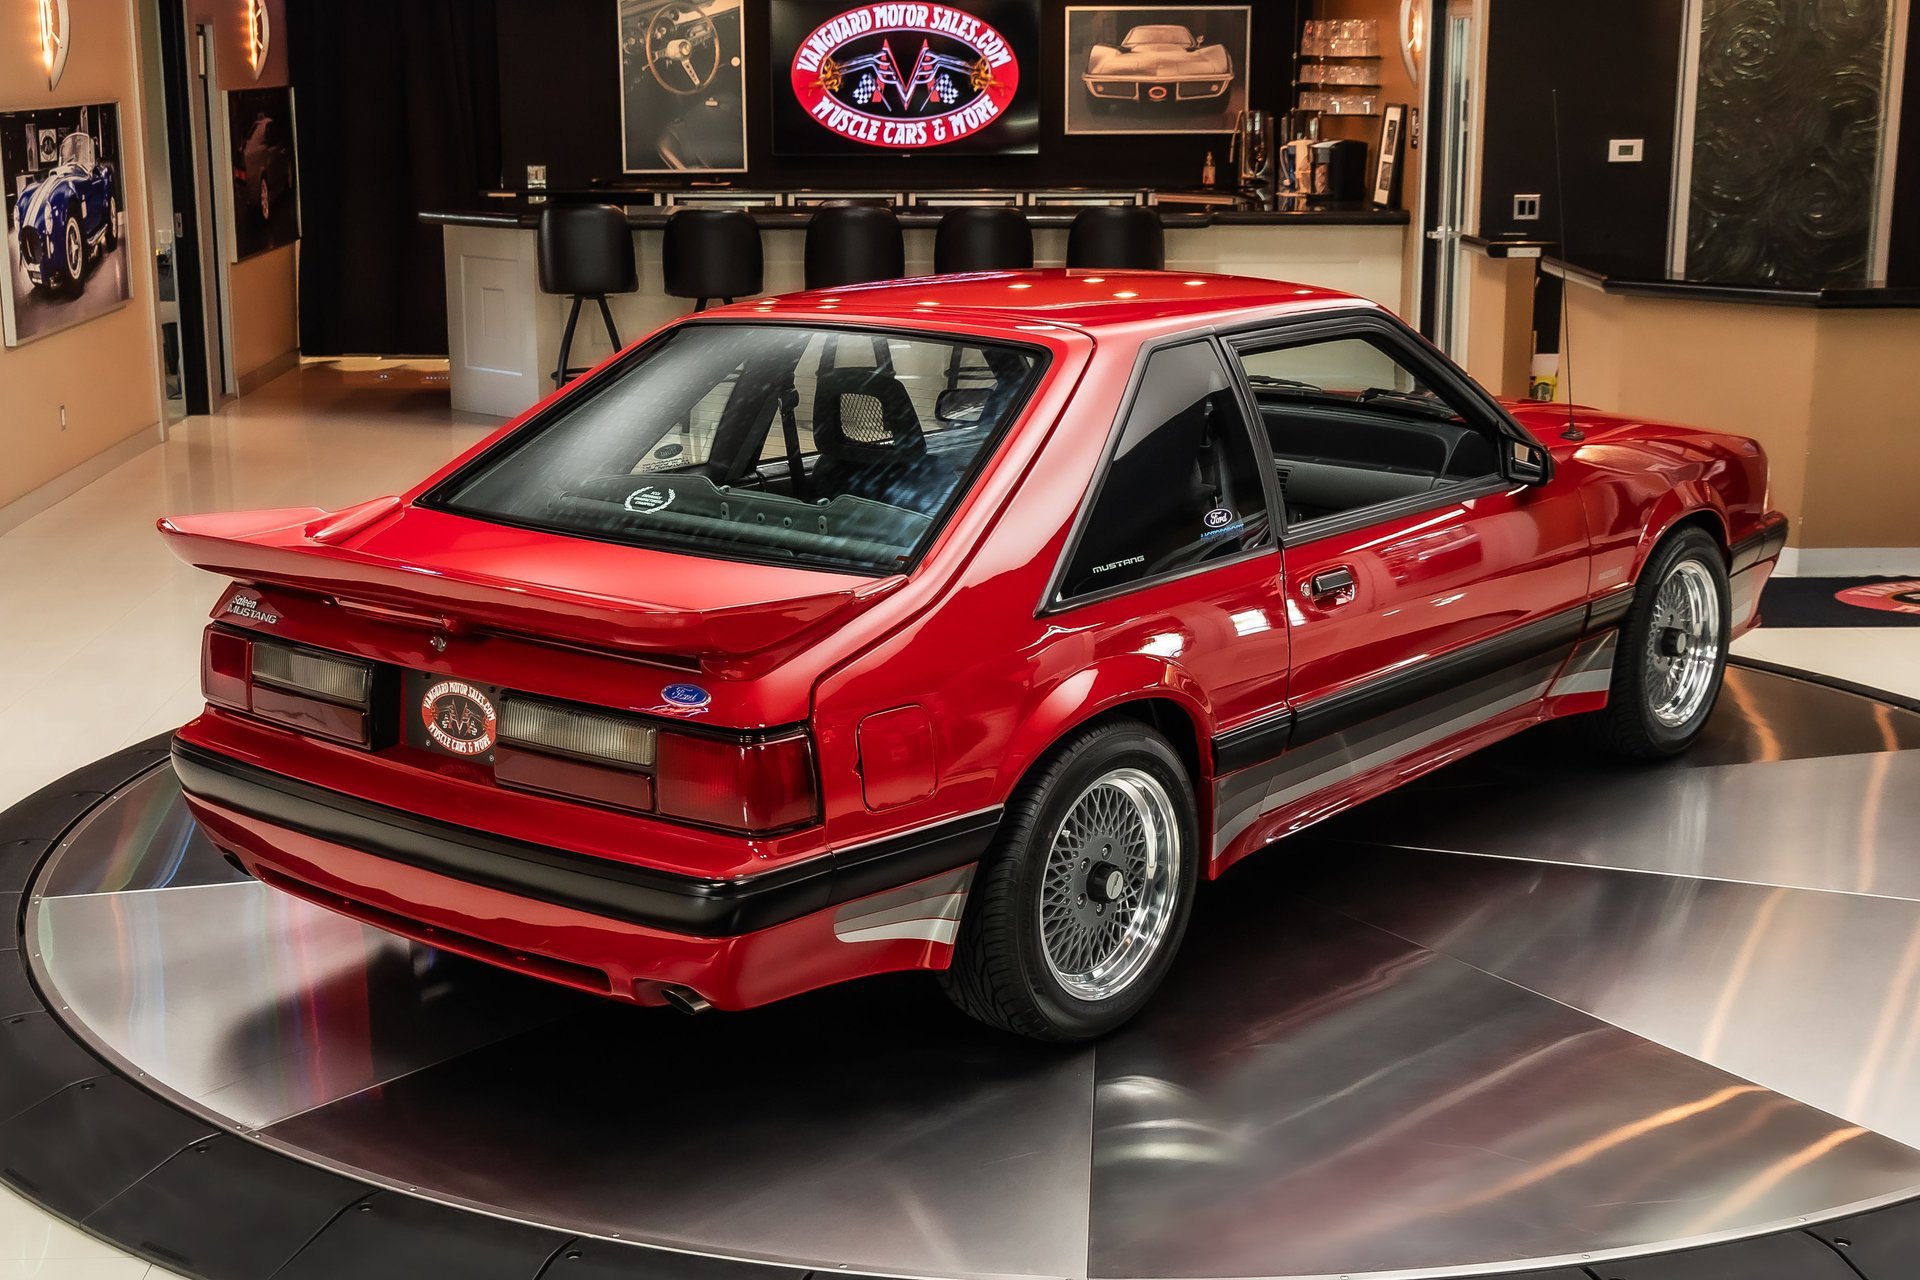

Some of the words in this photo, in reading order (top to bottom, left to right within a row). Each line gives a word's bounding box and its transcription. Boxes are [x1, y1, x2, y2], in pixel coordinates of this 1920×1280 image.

[796, 9, 872, 72] VANGUARD
[872, 4, 929, 28] MOTOR
[930, 6, 1012, 68] SALES.COM
[812, 95, 883, 142] MUSCLE
[882, 121, 927, 145] CARS
[931, 118, 947, 141] &
[948, 95, 999, 137] MORE
[1210, 511, 1227, 525] Ford
[1092, 555, 1145, 574] MUSTANG
[233, 594, 257, 609] Saleen
[227, 603, 277, 624] MUSTANG
[423, 683, 449, 709] VANGUARD
[449, 682, 469, 694] MOTOR
[467, 686, 496, 721] SALES.COM
[671, 686, 699, 701] Ford
[428, 722, 451, 748] MUSCLE
[451, 739, 467, 753] CARS
[467, 741, 473, 753] &
[473, 734, 491, 752] MORE
